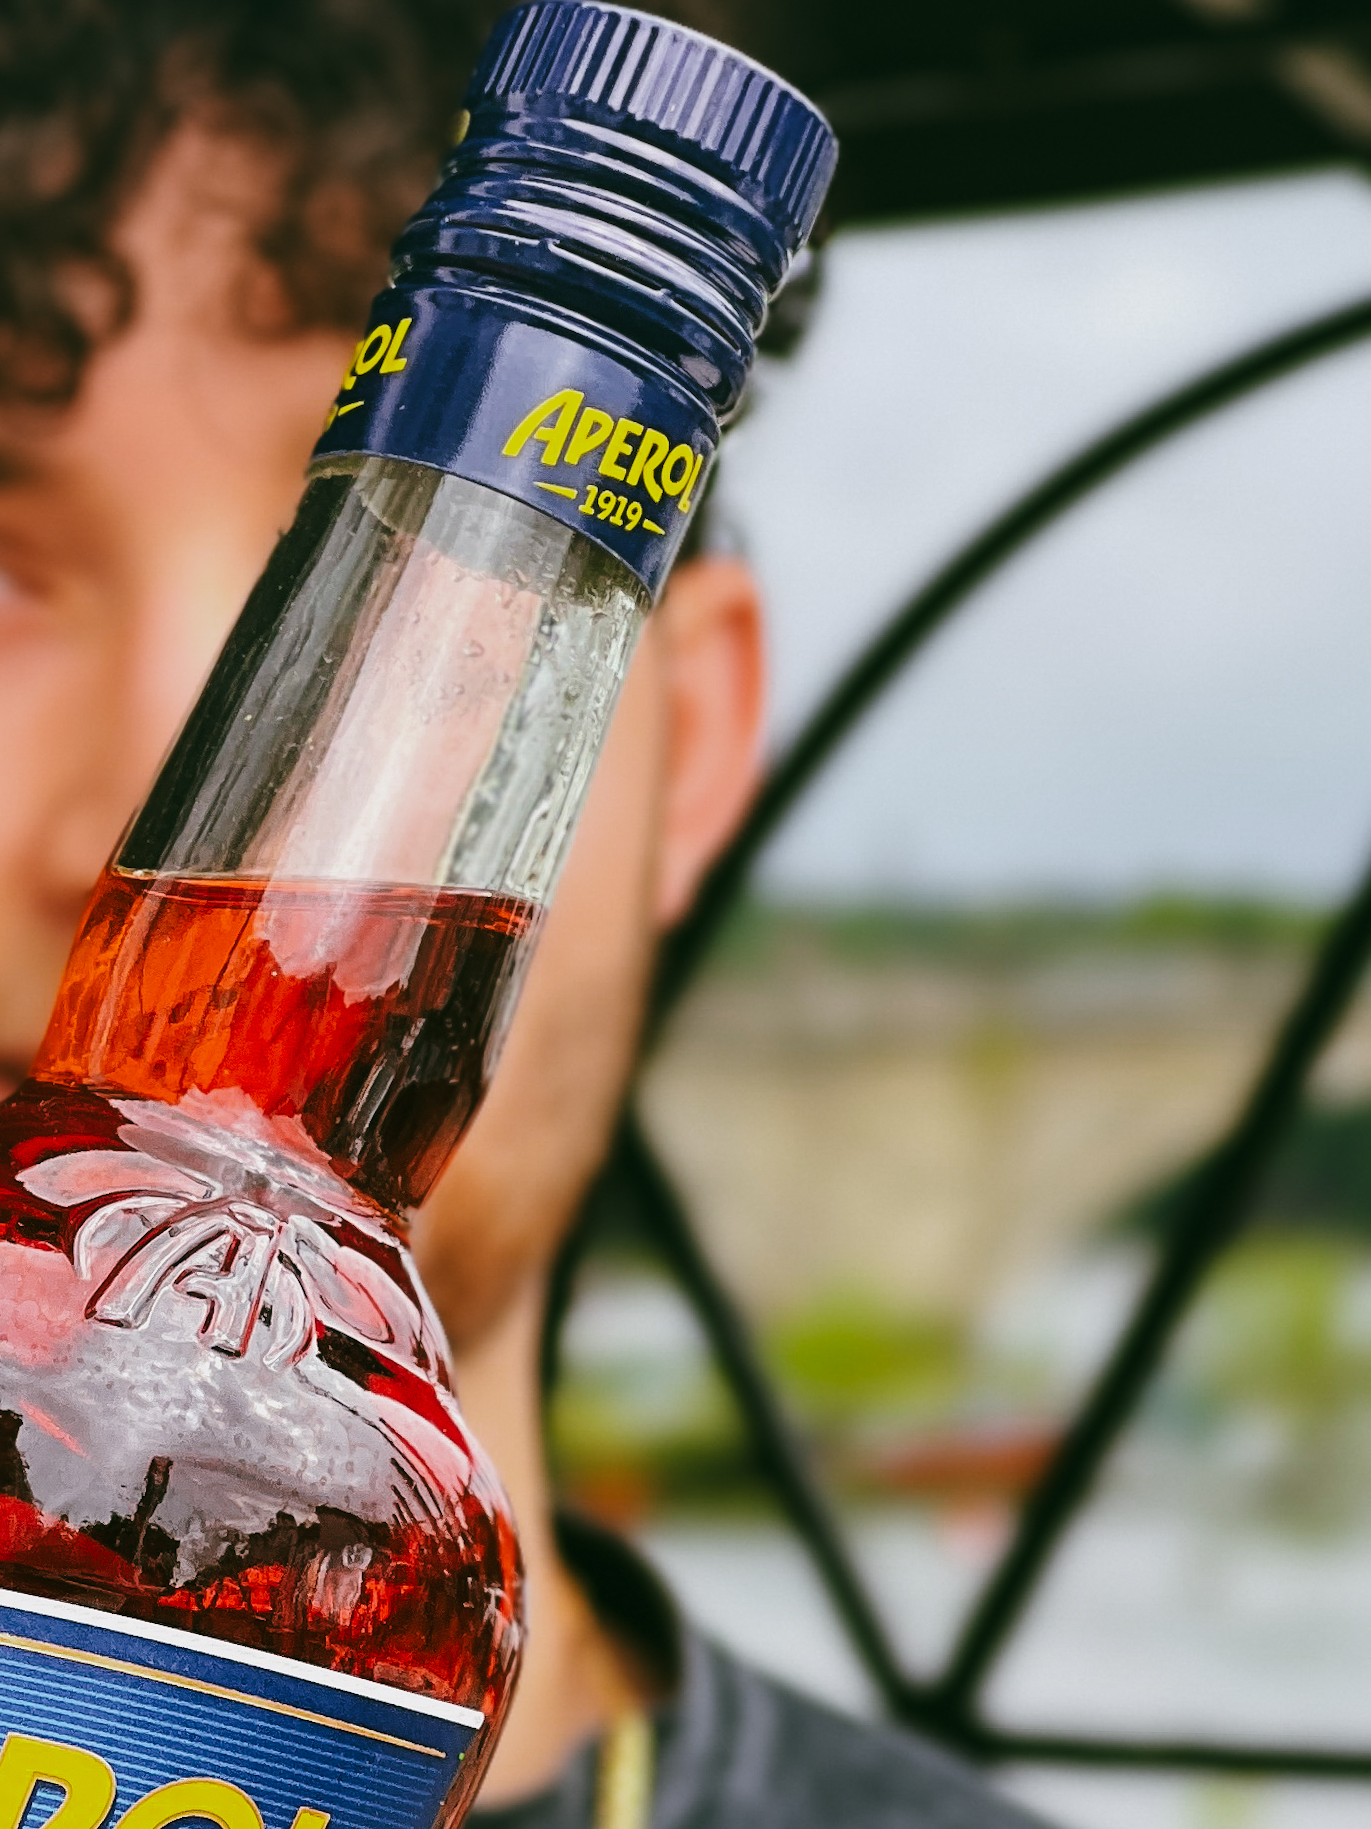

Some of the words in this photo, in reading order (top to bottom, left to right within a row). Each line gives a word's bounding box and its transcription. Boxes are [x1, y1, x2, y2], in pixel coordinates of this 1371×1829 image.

[343, 317, 413, 391] OL
[502, 388, 704, 514] APEROL
[579, 484, 645, 531] 1919
